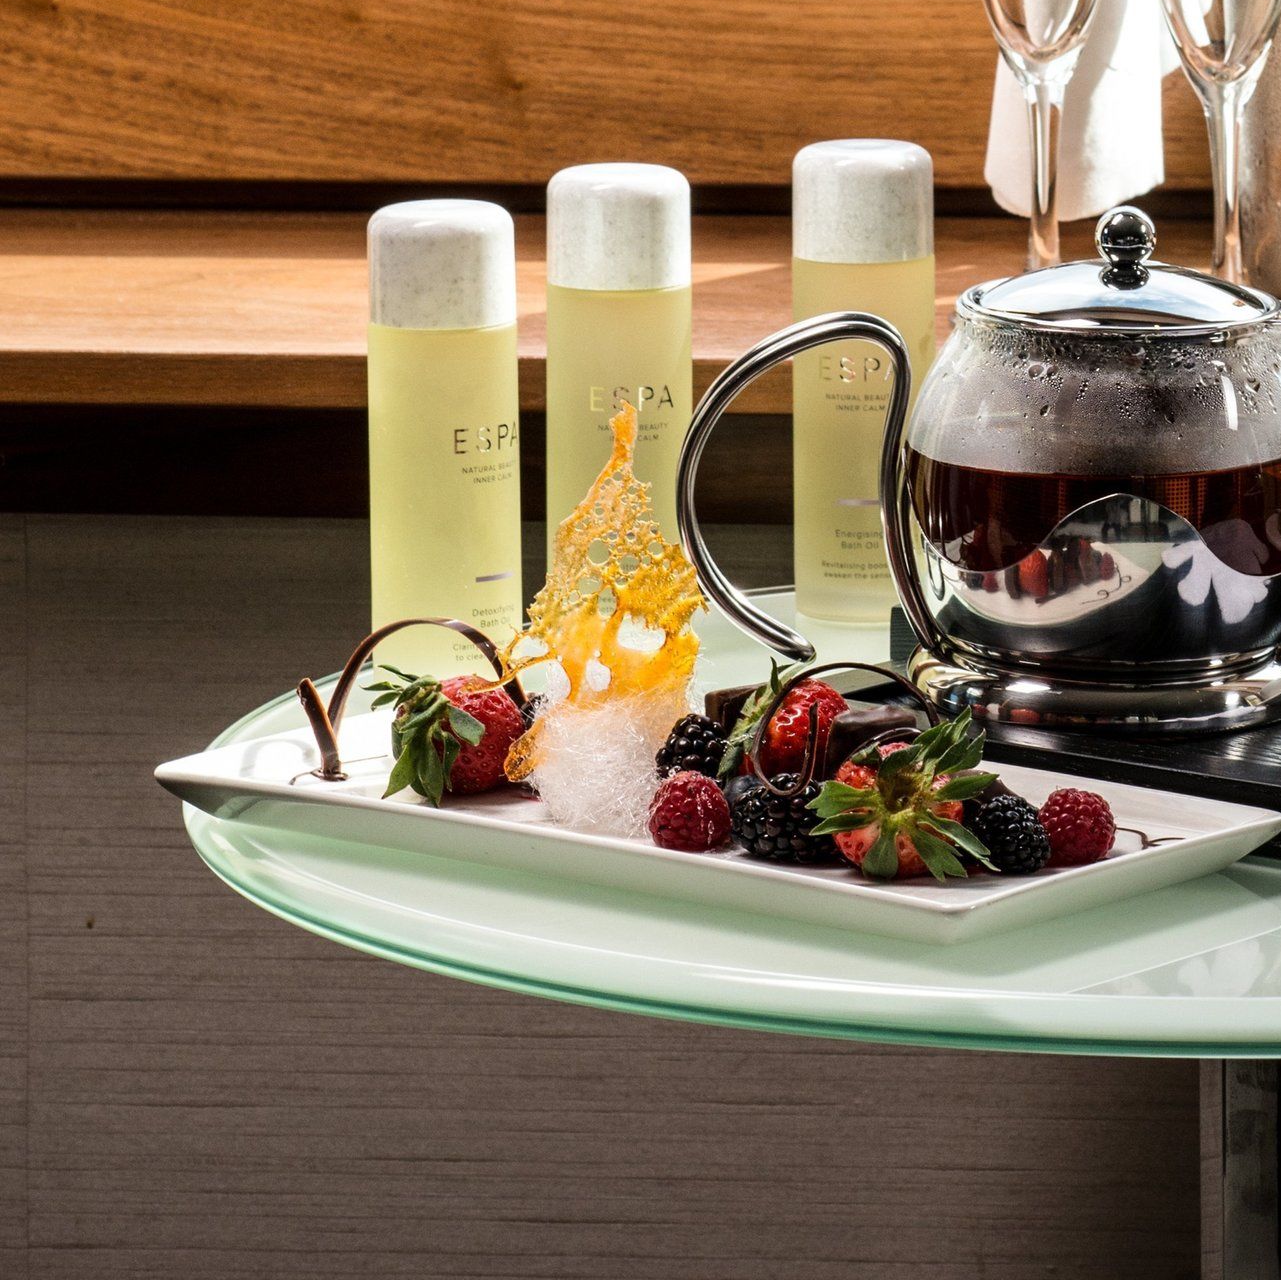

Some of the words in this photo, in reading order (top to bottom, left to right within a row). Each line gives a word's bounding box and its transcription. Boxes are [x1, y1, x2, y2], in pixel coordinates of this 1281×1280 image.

[590, 385, 674, 412] ESPA
[826, 393, 862, 401] NATURAL
[836, 404, 860, 412] INNER
[862, 404, 886, 412] CALM
[637, 434, 660, 442] CALM
[462, 464, 496, 474] NATURAL
[841, 541, 863, 550] Bath
[865, 541, 879, 550] Oil
[480, 618, 499, 628] Bath
